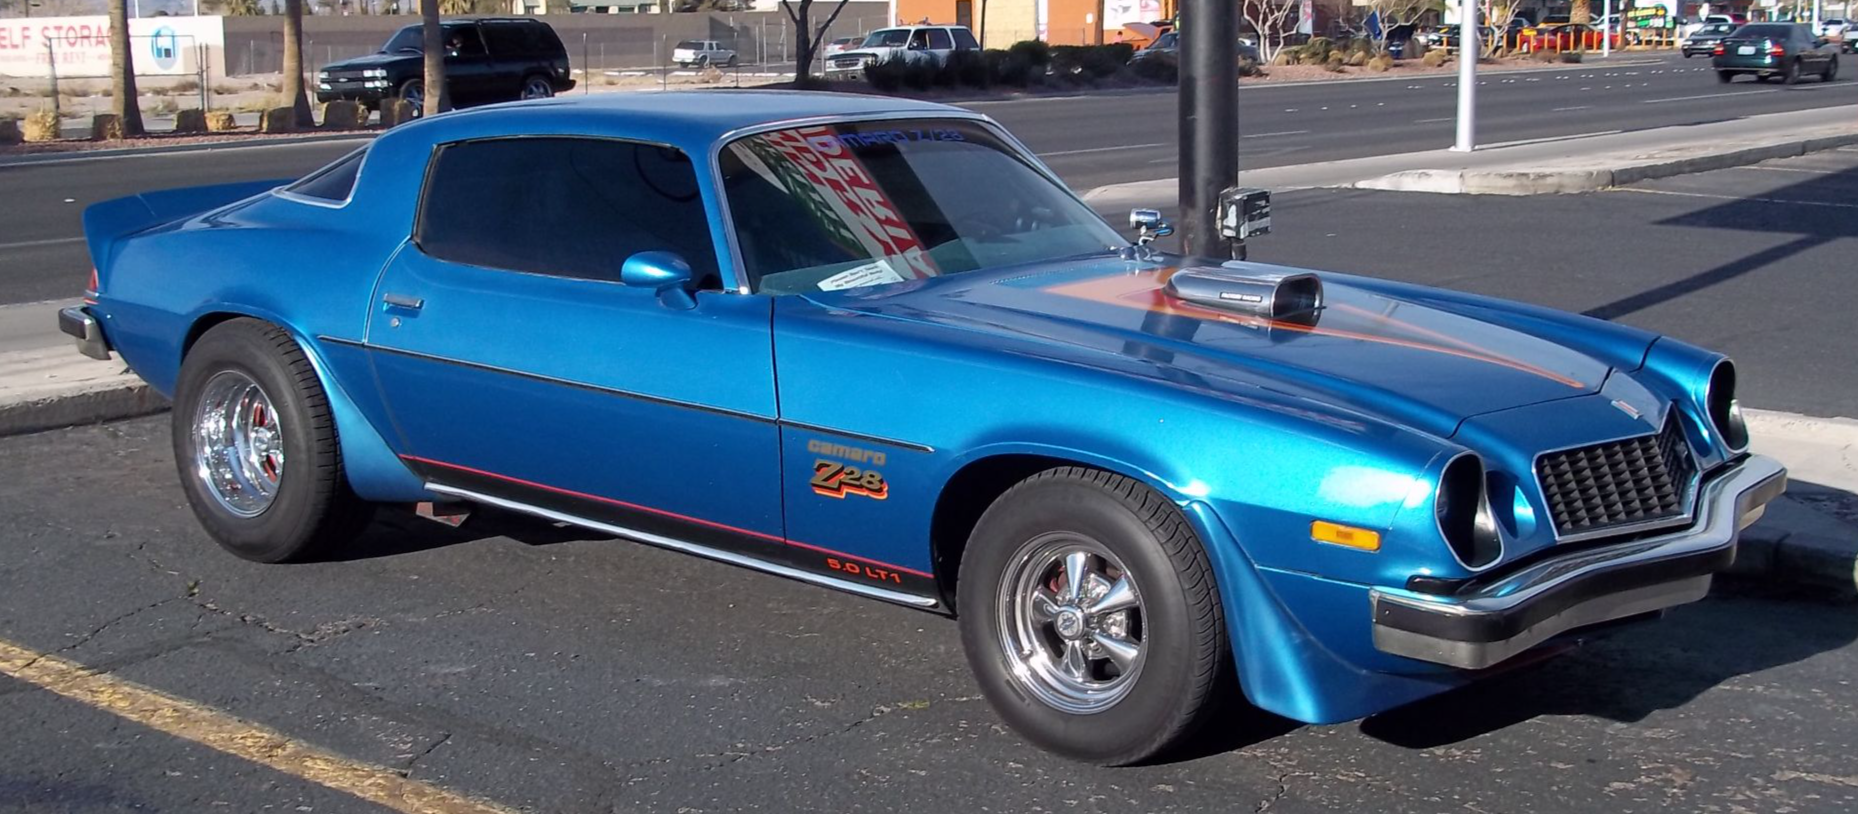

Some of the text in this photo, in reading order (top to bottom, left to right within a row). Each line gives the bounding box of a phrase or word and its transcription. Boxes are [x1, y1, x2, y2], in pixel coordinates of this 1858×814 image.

[808, 439, 886, 466] camaro
[810, 458, 888, 499] Z28
[827, 557, 901, 584] 5.0 LT1
